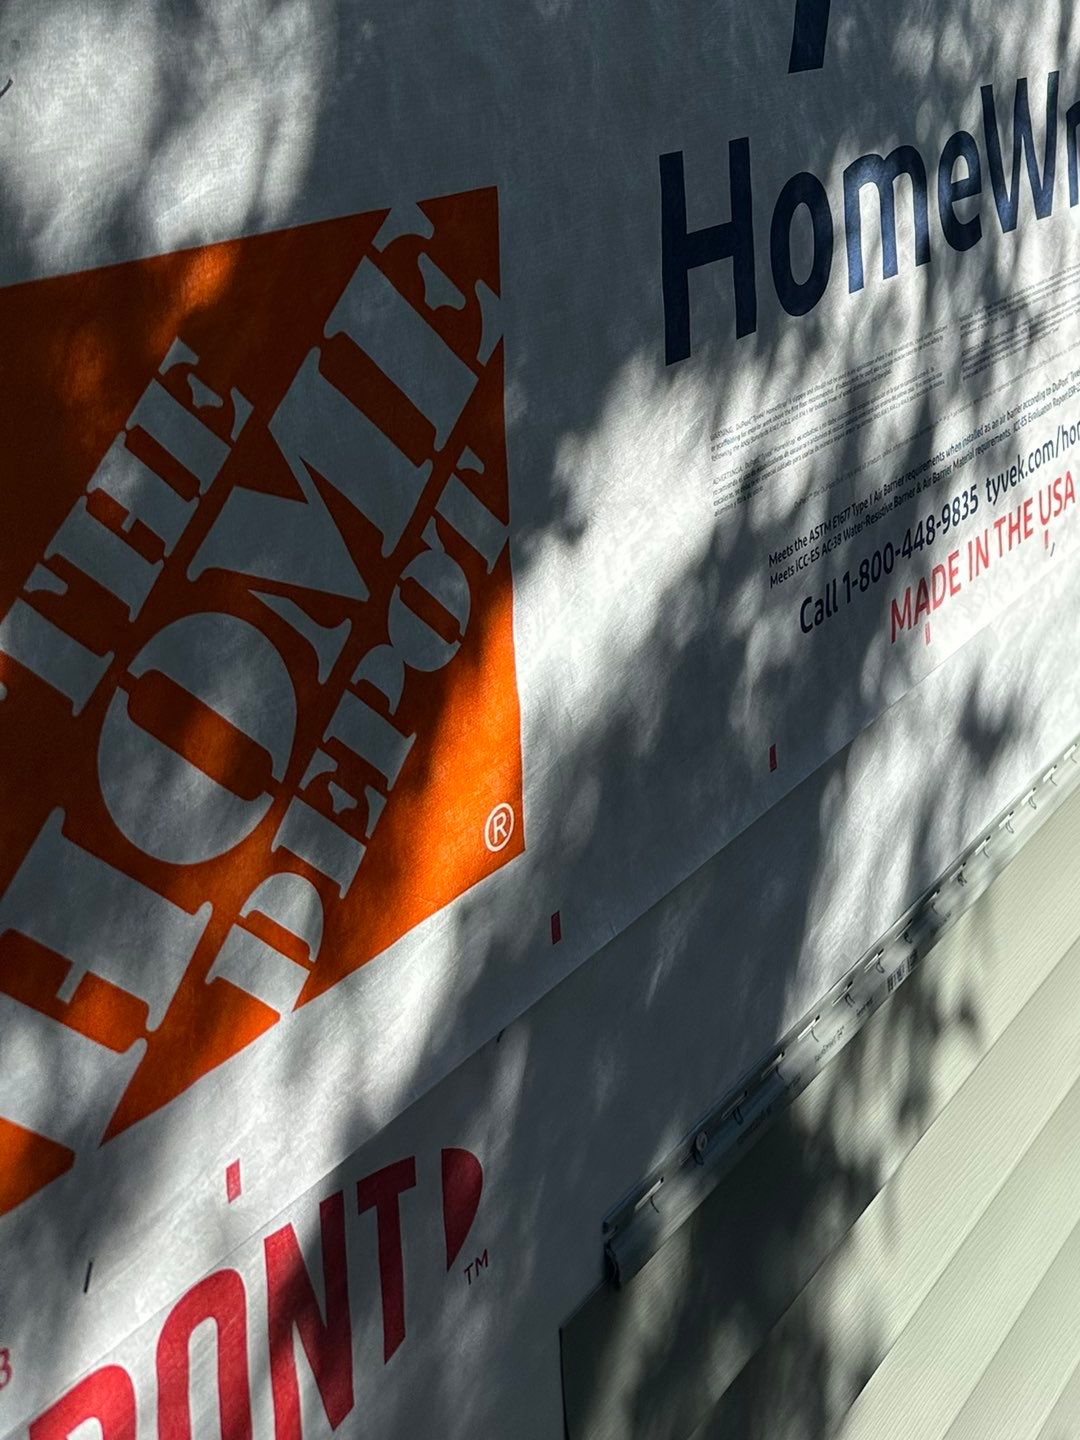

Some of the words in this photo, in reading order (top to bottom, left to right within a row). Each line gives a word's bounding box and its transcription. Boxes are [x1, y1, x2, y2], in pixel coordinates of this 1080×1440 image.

[0, 336, 254, 717] THE
[768, 545, 794, 568] Meets
[794, 535, 808, 551] the
[808, 521, 833, 544] ASTM
[852, 499, 869, 519] Type
[873, 489, 884, 504] Air
[883, 477, 905, 498] Barrier
[905, 452, 946, 486] requirements
[946, 442, 962, 458] when
[1022, 392, 1046, 416] according
[769, 567, 795, 588] Meets
[795, 548, 820, 573] ICC-ES
[893, 489, 916, 508] Barrier
[922, 475, 933, 492] Air
[932, 464, 952, 486] Barrier
[800, 578, 838, 634] Call
[843, 484, 979, 605] 1-800-448-9835
[890, 550, 961, 645] MADE
[967, 528, 990, 582] IN
[995, 498, 1034, 558] THE
[1039, 470, 1076, 525] USA
[0, 201, 504, 1162] HOME
[206, 445, 510, 1013] DEPOT
